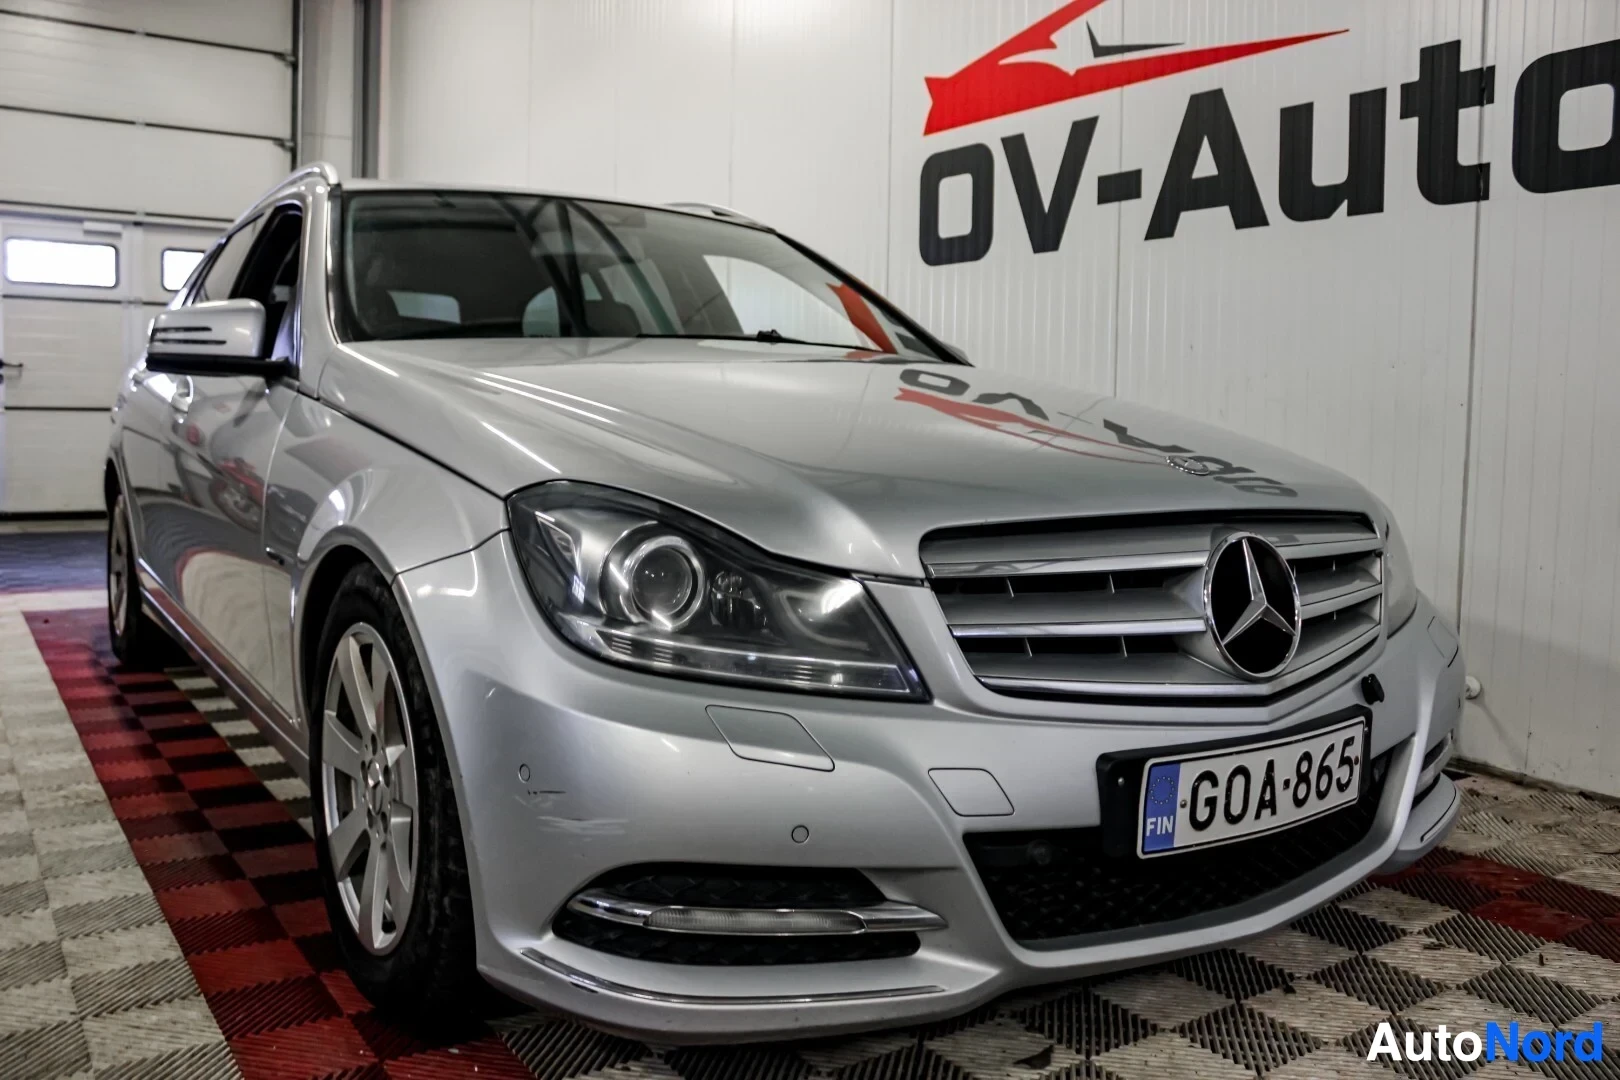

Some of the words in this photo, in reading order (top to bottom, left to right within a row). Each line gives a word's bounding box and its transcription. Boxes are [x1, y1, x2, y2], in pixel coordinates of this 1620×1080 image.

[919, 39, 1620, 267] OV-Auto
[1145, 815, 1174, 837] FIN
[1188, 736, 1356, 832] GOA-865
